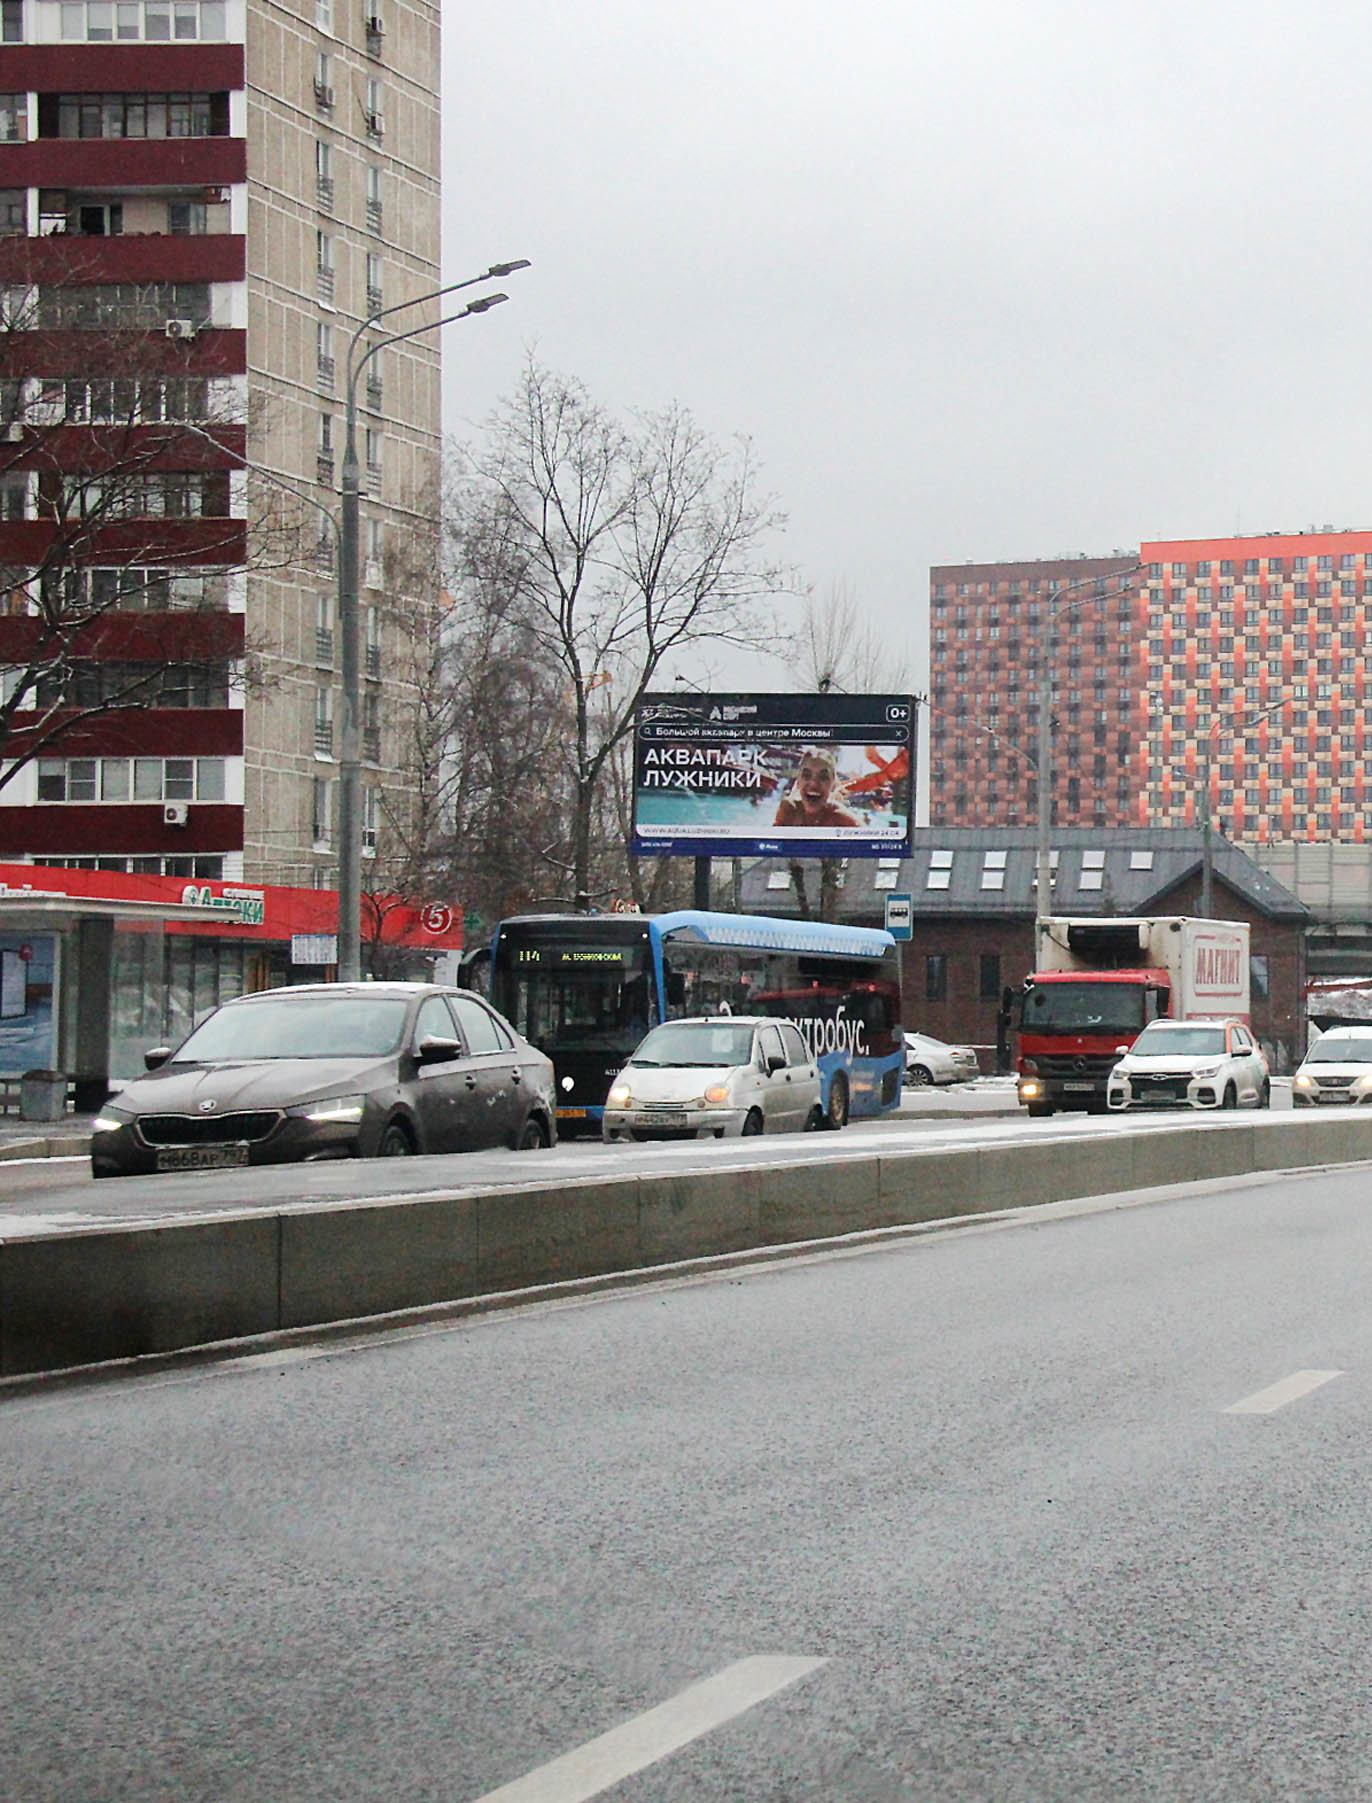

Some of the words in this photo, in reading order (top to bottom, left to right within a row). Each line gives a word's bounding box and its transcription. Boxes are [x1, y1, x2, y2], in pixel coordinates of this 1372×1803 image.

[890, 708, 907, 718] 0+
[656, 728, 699, 736] Большой
[756, 730, 789, 738] центре
[792, 729, 831, 737] Москвы
[643, 749, 767, 766] АКВАПАРК
[643, 770, 761, 788] ЛУЖНИКИ
[428, 908, 444, 929] 5
[520, 951, 540, 961] 114
[1196, 947, 1241, 985] МАГНИТ
